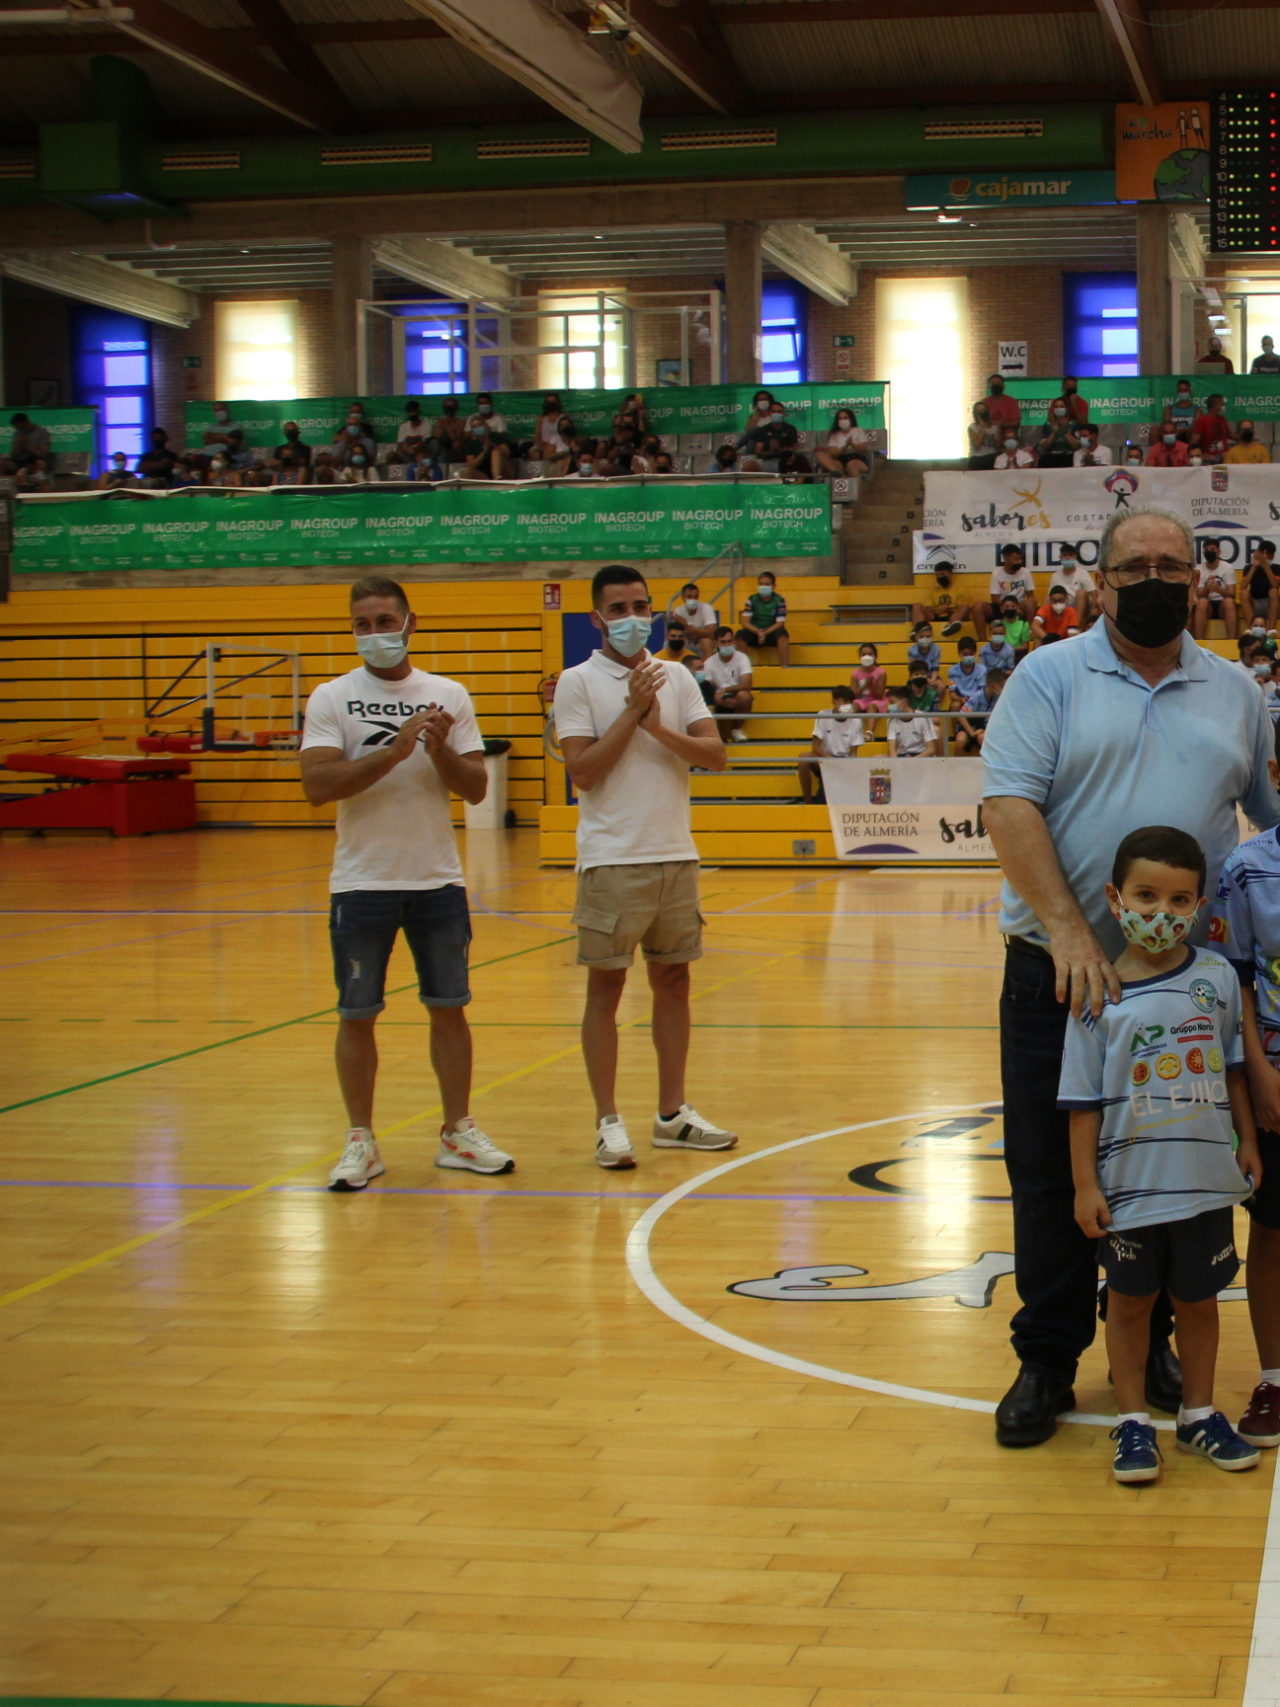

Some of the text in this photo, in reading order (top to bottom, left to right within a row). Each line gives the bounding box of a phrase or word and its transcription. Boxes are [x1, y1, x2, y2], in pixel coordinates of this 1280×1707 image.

[1219, 92, 1226, 101] 4
[1219, 105, 1226, 115] 5
[1219, 119, 1226, 128] 6
[1120, 120, 1173, 141] marcha
[1219, 132, 1226, 141] 7
[1219, 145, 1226, 154] 8
[1219, 159, 1226, 168] 9
[1216, 172, 1227, 181] 10
[975, 176, 1072, 201] cajamar
[1216, 185, 1227, 194] 11
[1216, 198, 1227, 208] 12
[1216, 212, 1227, 221] 13
[1216, 225, 1227, 234] 14
[1216, 239, 1227, 248] 15
[819, 396, 882, 410] INAGROUP
[1089, 397, 1154, 409] INAGROUP
[680, 403, 742, 417] INAGROUP
[1101, 408, 1138, 417] BIOTECH
[1191, 497, 1250, 507] DIPUTACIÓN
[672, 509, 744, 522] INAGROUP
[750, 507, 823, 521] INAGROUP
[1193, 506, 1248, 517] DE ALMERÍA
[440, 512, 510, 526] INAGROUP
[517, 511, 587, 526] INAGROUP
[594, 510, 665, 524] INAGROUP
[961, 503, 1051, 532] sabores
[143, 521, 209, 534] INAGROUP
[216, 519, 283, 532] INAGROUP
[291, 517, 358, 531] INAGROUP
[365, 516, 433, 529] INAGROUP
[605, 523, 645, 532] BIOTECH
[683, 521, 724, 530] BIOTECH
[762, 519, 803, 529] BIOTECH
[70, 523, 135, 535] INAGROUP
[302, 529, 340, 538] BIOTECH
[376, 528, 415, 538] BIOTECH
[452, 526, 490, 535] BIOTECH
[528, 525, 567, 534] BIOTECH
[80, 536, 118, 545] BIOTECH
[153, 534, 191, 543] BIOTECH
[227, 531, 265, 541] BIOTECH
[347, 700, 443, 717] Reebo
[842, 811, 919, 825] DIPUTACIÓN
[843, 825, 919, 837] DE ALMERÍA
[1170, 1023, 1197, 1035] Gruppo
[1131, 1091, 1162, 1118] EL
